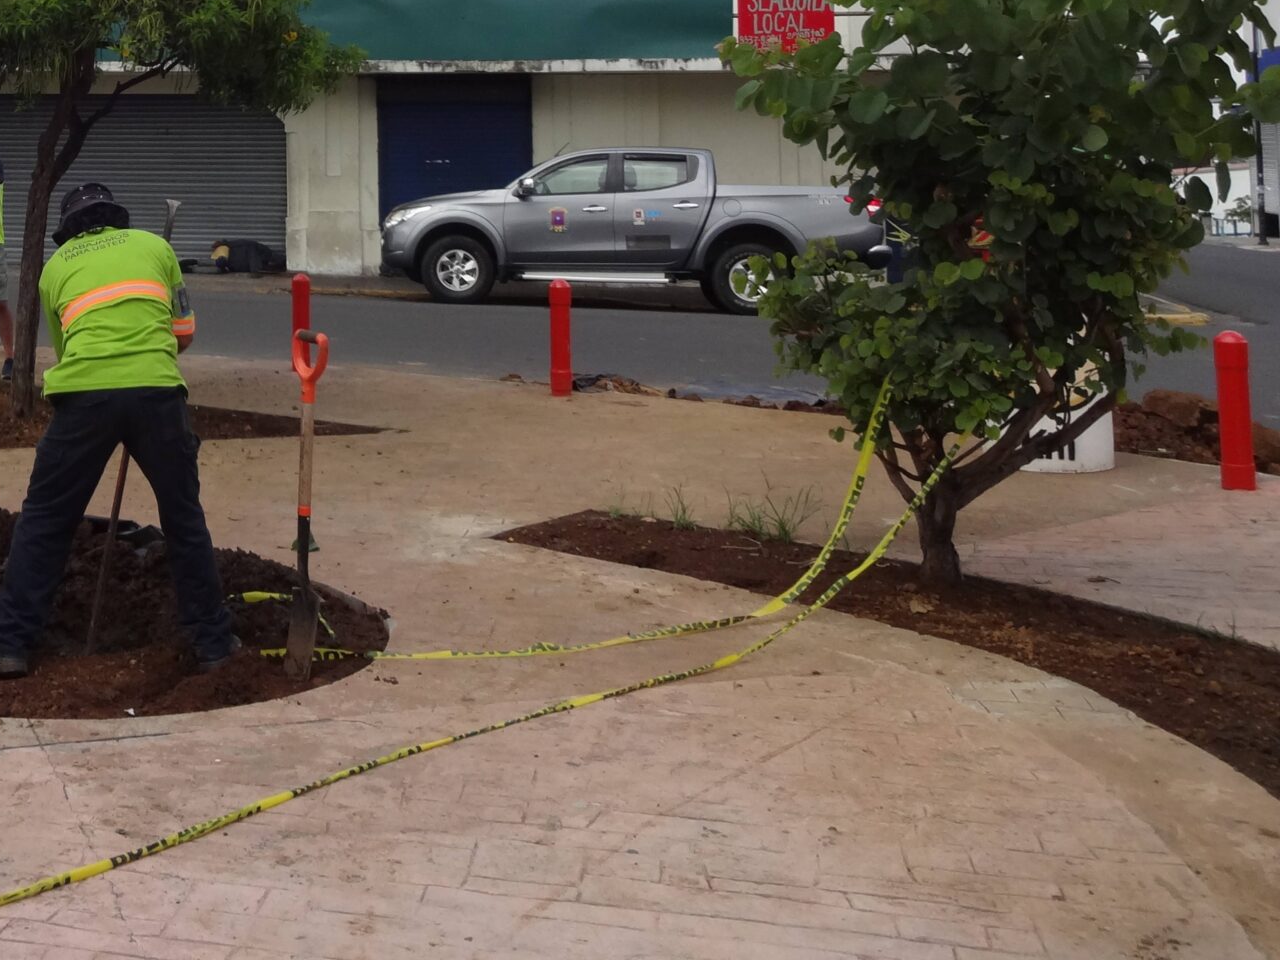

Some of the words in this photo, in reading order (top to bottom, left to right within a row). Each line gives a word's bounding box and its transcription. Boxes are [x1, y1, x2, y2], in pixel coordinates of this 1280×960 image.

[753, 11, 809, 35] LOCAL
[64, 248, 91, 262] PARA
[93, 239, 126, 252] USTED
